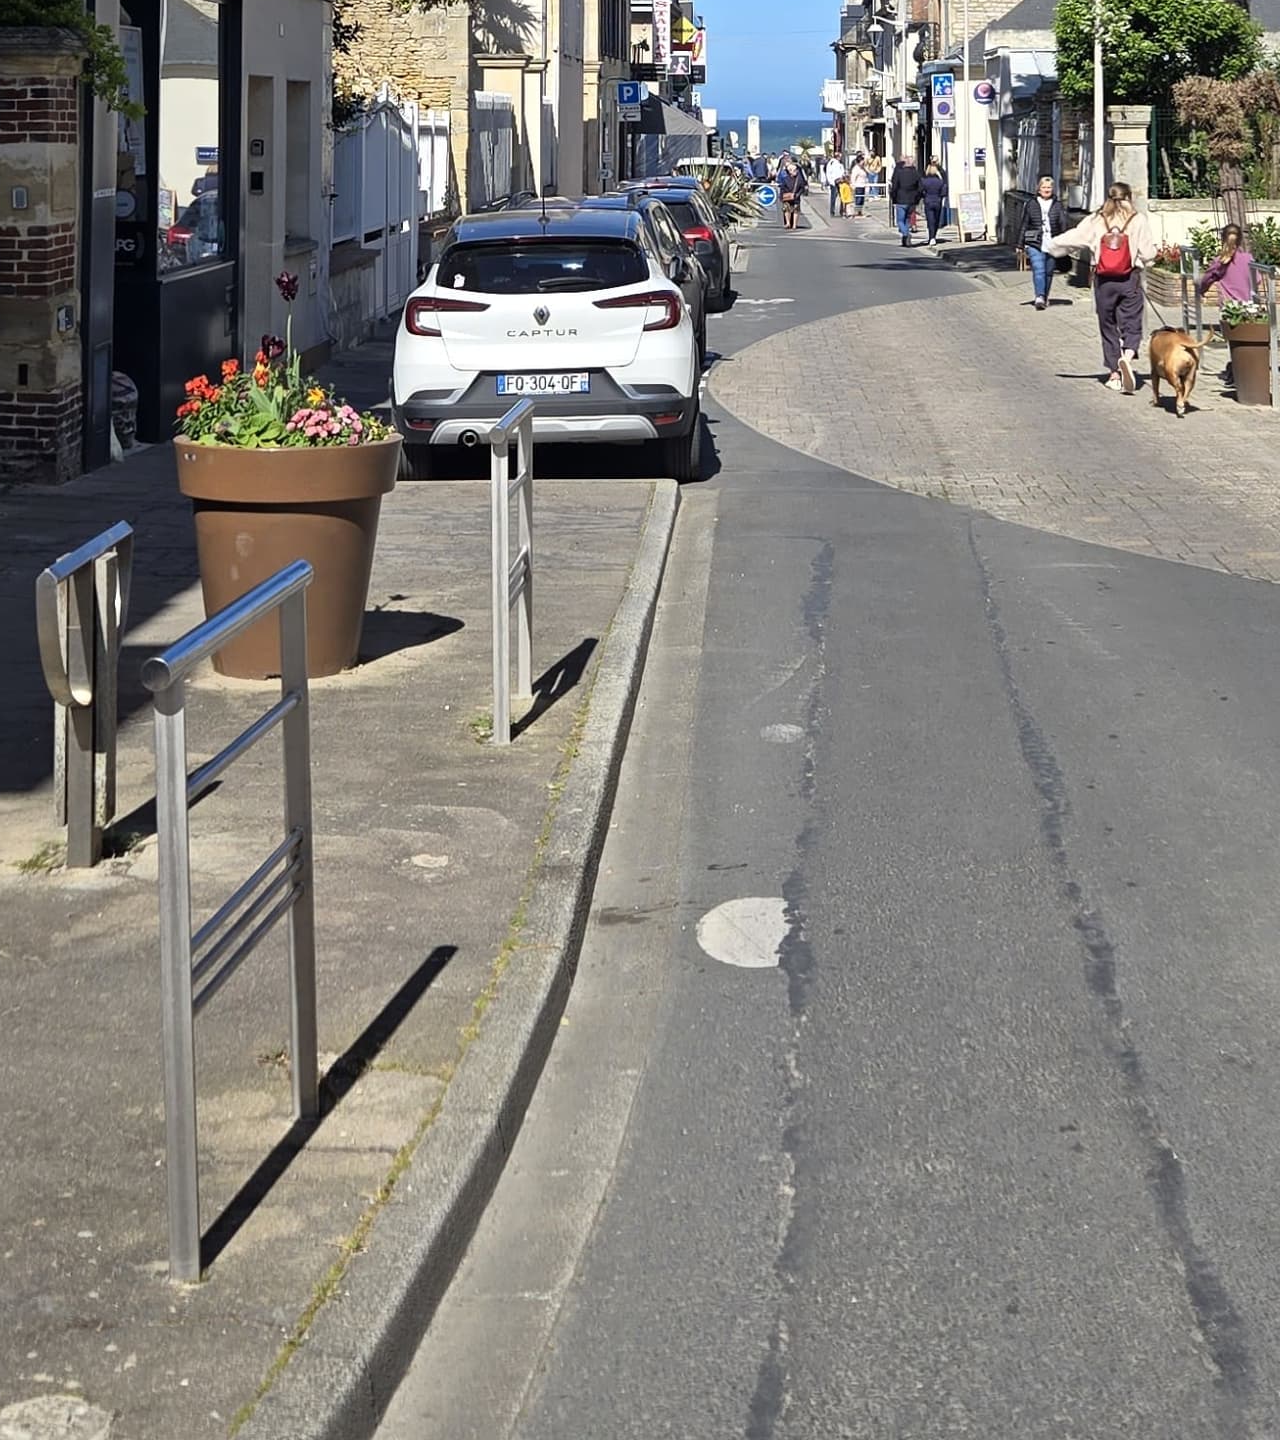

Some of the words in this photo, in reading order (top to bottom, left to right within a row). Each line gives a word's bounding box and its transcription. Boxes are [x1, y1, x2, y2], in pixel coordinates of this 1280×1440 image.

[623, 86, 634, 101] P
[114, 238, 136, 252] PG
[506, 329, 578, 337] CAPTUR
[506, 375, 579, 391] FQ-304-QF
